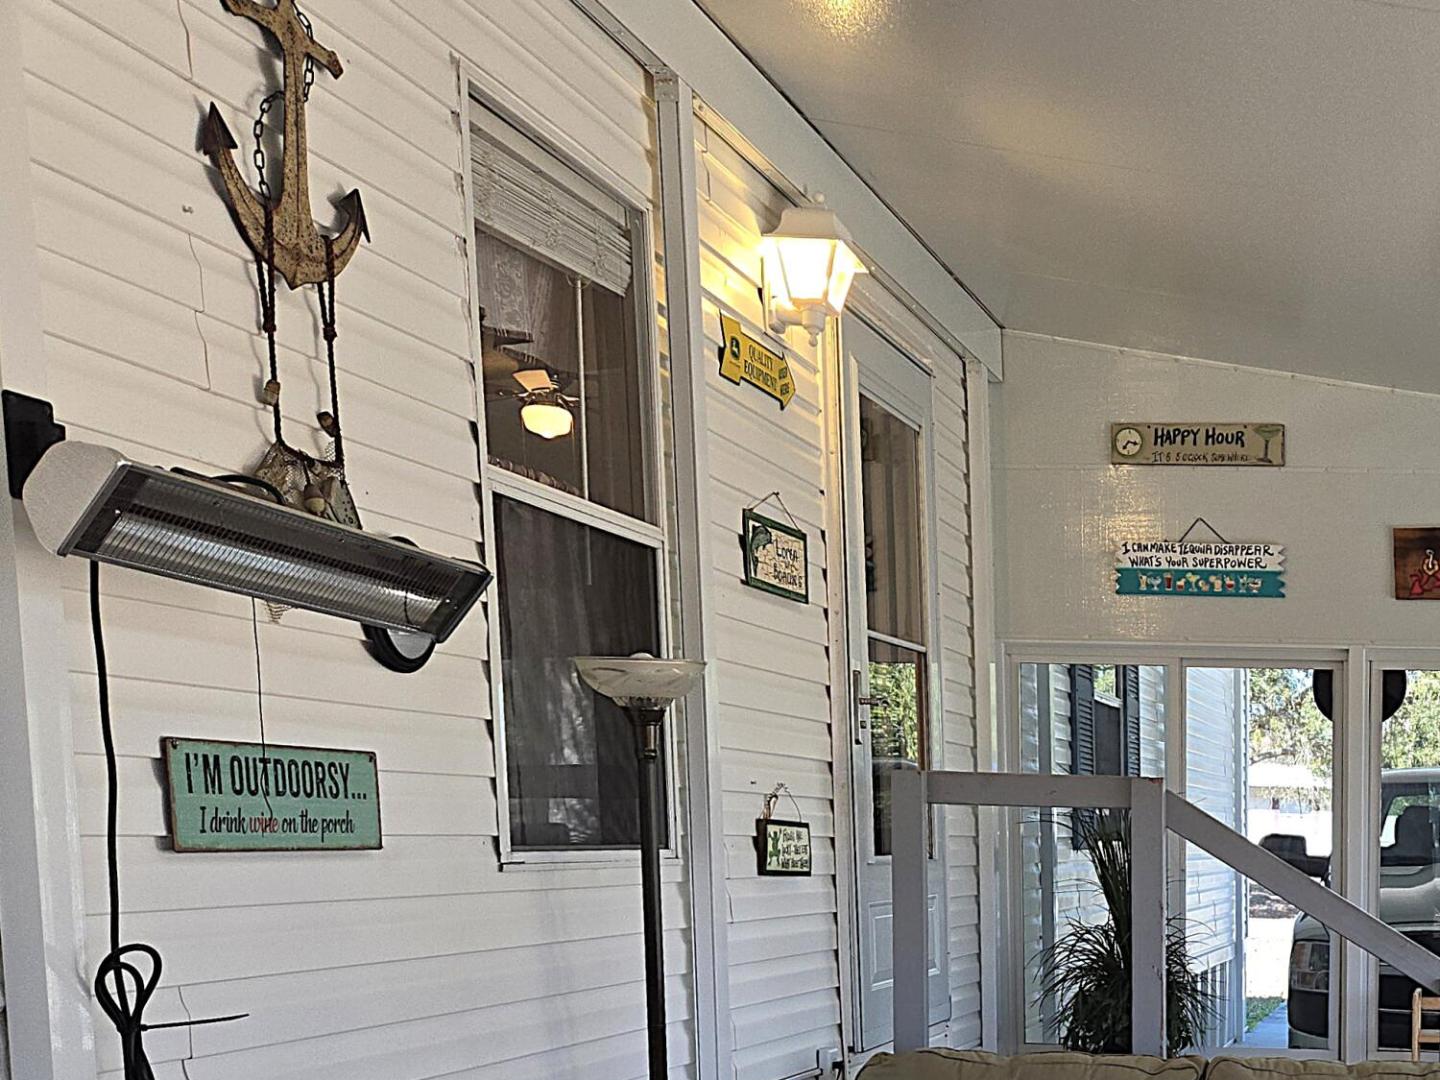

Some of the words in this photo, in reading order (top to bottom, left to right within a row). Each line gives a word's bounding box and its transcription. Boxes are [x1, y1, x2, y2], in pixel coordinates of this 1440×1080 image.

[1154, 427, 1200, 447] HAPPY
[1205, 427, 1245, 448] HOUR
[1122, 541, 1130, 554] I
[1132, 542, 1150, 552] CAN
[1150, 542, 1177, 554] MAKE
[1178, 543, 1213, 555] TEQUILA
[1214, 543, 1274, 556] DISAPPEAR
[1129, 555, 1162, 568] WHAT'S
[1165, 556, 1188, 568] YOUR
[1192, 556, 1267, 569] SUPERPOWER
[185, 752, 223, 795] I'M
[199, 807, 207, 834] I
[210, 808, 248, 835] drink
[250, 811, 279, 835] wine
[281, 818, 298, 834] on
[299, 809, 319, 834] the
[320, 810, 355, 842] porch
